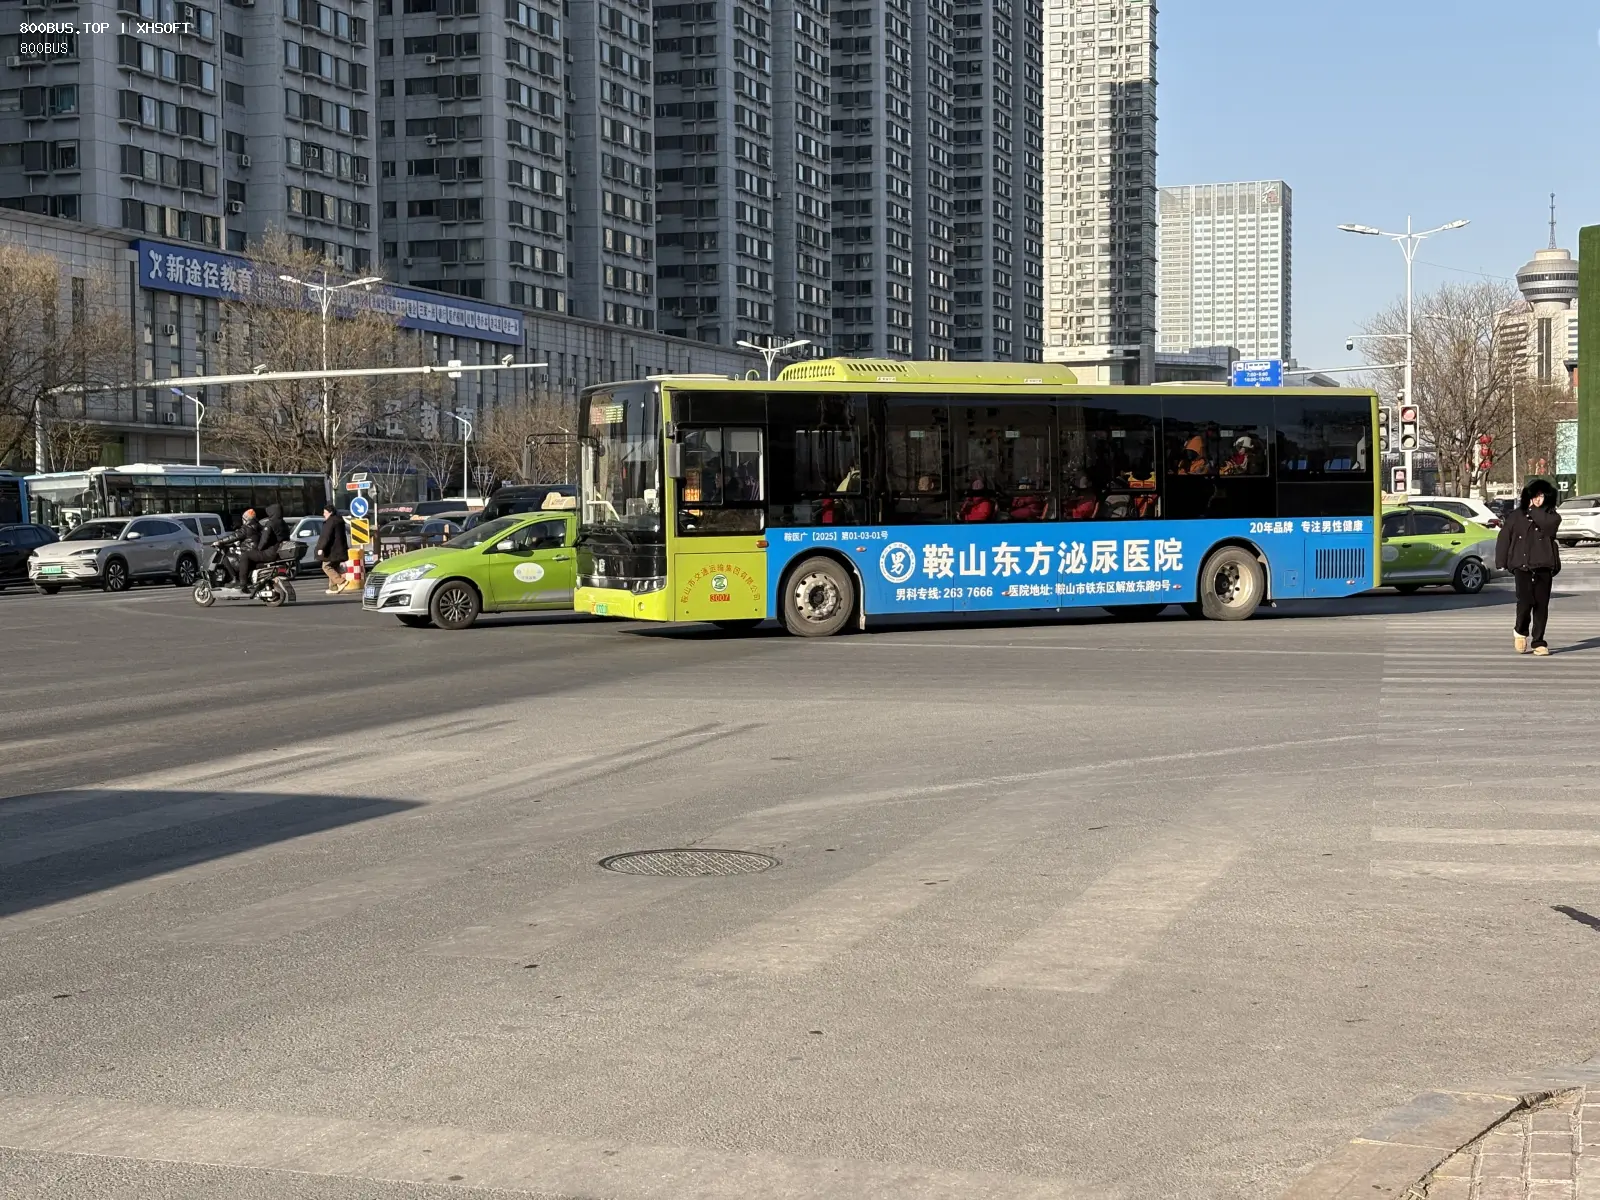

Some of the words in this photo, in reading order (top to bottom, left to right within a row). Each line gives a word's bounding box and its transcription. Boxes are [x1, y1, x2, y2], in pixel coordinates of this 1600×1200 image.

[166, 253, 254, 296] 新途径教育
[1249, 521, 1294, 534] 20年品牌
[1301, 520, 1364, 533] 专注男性健康
[890, 551, 906, 575] 男
[922, 537, 1184, 579] 鞍山东方泌尿医院
